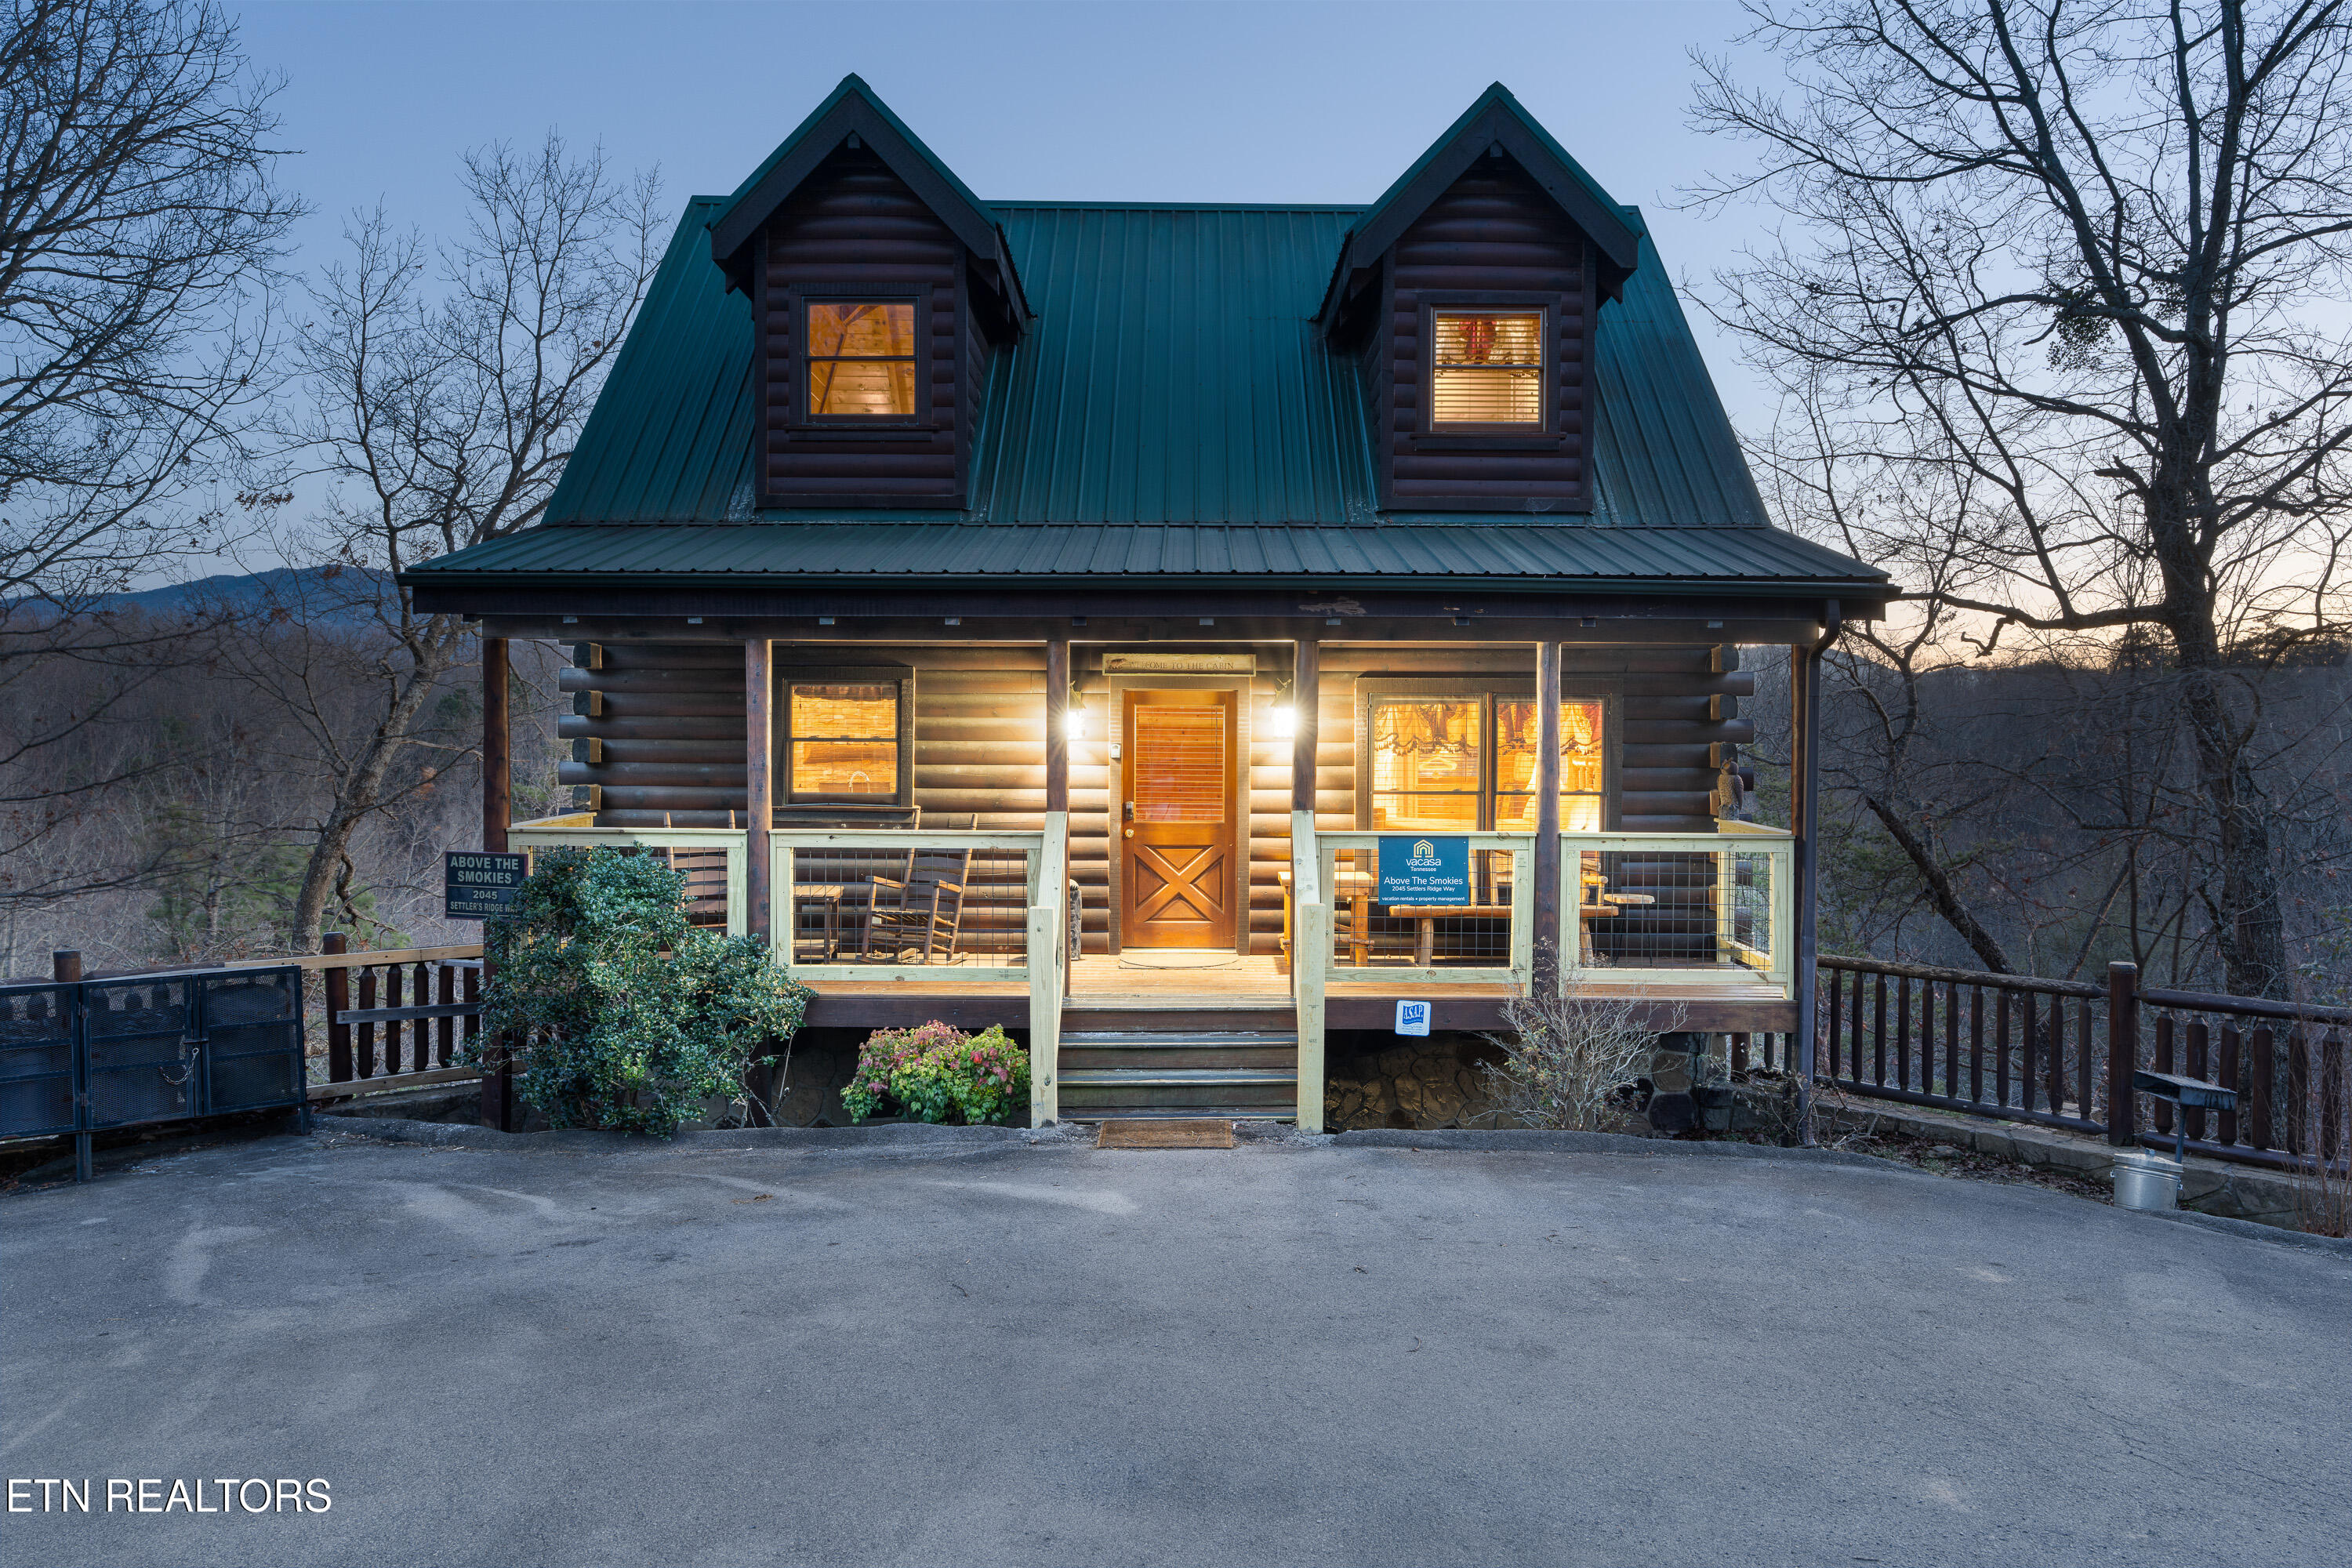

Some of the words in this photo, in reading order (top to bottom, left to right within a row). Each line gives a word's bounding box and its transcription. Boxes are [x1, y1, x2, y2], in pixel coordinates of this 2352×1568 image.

[450, 856, 491, 869] ABOVE
[495, 858, 519, 870] THE
[457, 870, 512, 884] SMOKIES
[1384, 877, 1410, 885] Above
[1412, 877, 1428, 885] The
[1429, 877, 1463, 885] Smokies
[473, 890, 498, 900] 2045
[450, 901, 483, 911] SETTLER'S
[485, 902, 503, 913] RIDGE
